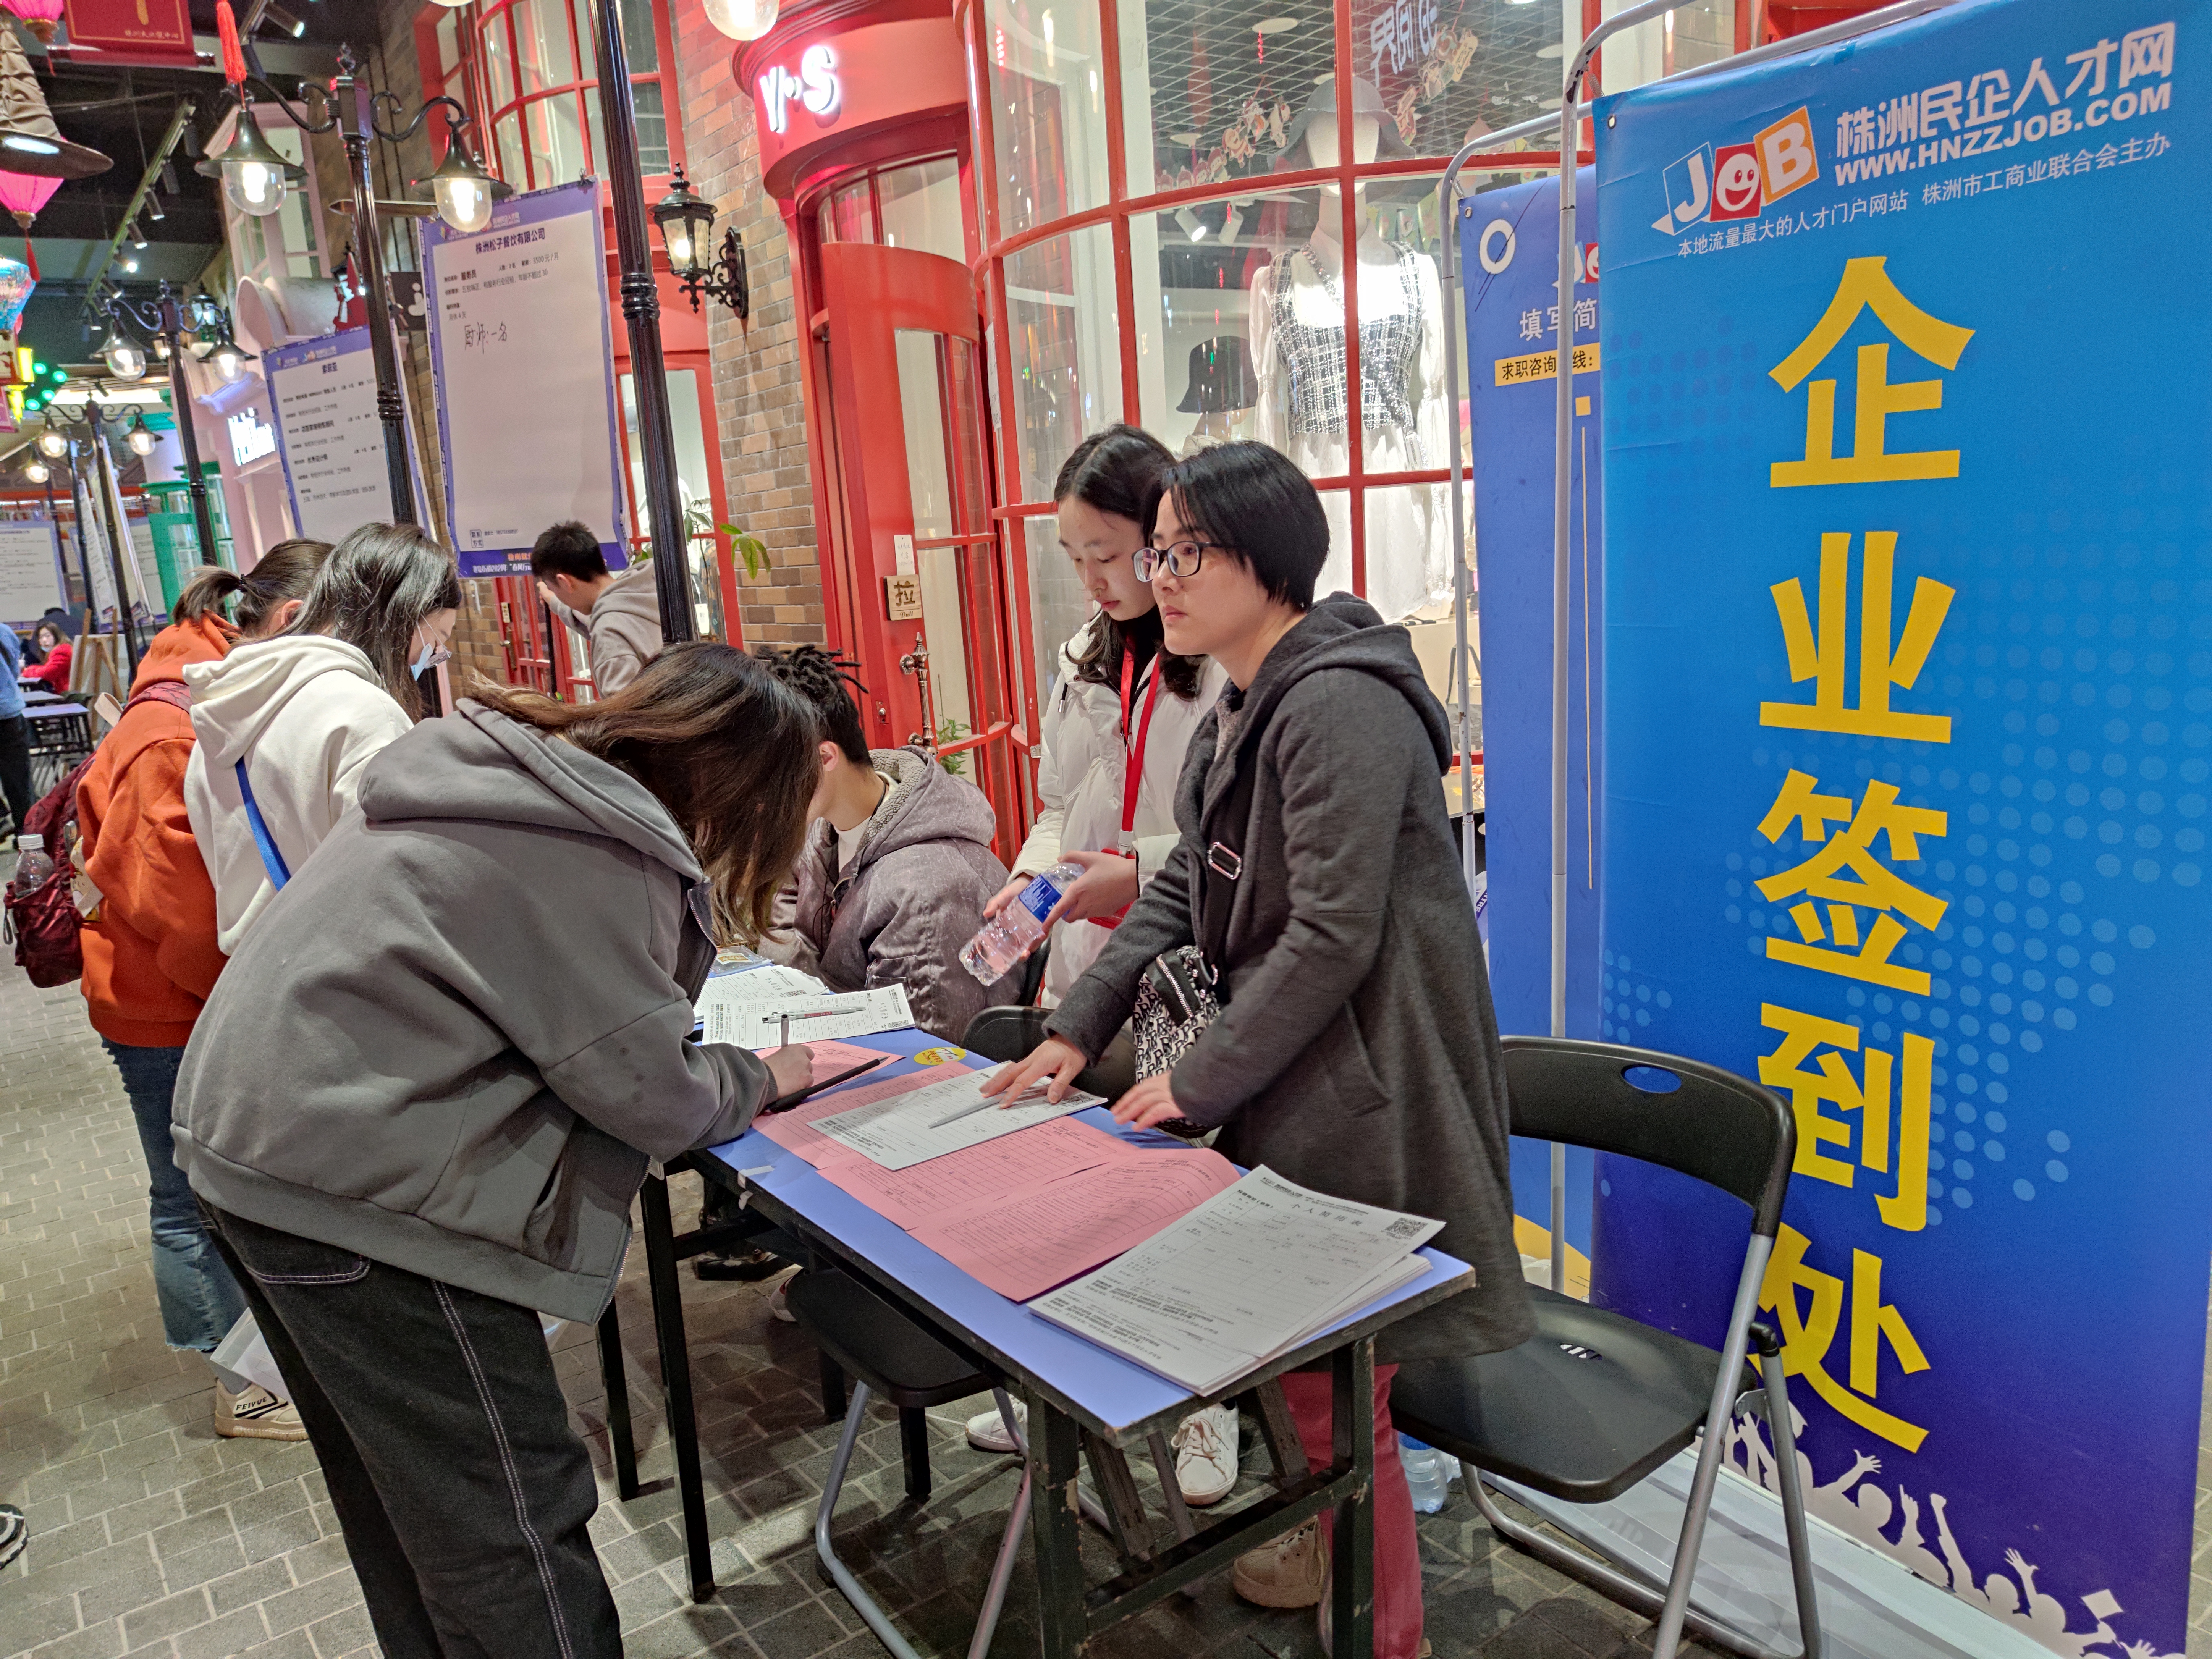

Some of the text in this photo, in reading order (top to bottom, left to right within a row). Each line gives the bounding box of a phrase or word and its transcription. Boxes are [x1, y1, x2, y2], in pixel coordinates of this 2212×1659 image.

[1836, 21, 2175, 158] 株洲民企人才网
[1835, 82, 2172, 186] WWW.HNZZJOB.COM
[1678, 132, 2171, 258] 本地流量最大的人才门户网站 株洲市工商业联合会主办
[476, 228, 545, 254] 株洲松子餐饮有限公司
[1502, 350, 1593, 380] 求职咨询线：
[893, 581, 915, 607] 拉
[1746, 256, 1976, 1454] 企业签到处
[236, 1396, 267, 1410] FEIYUE
